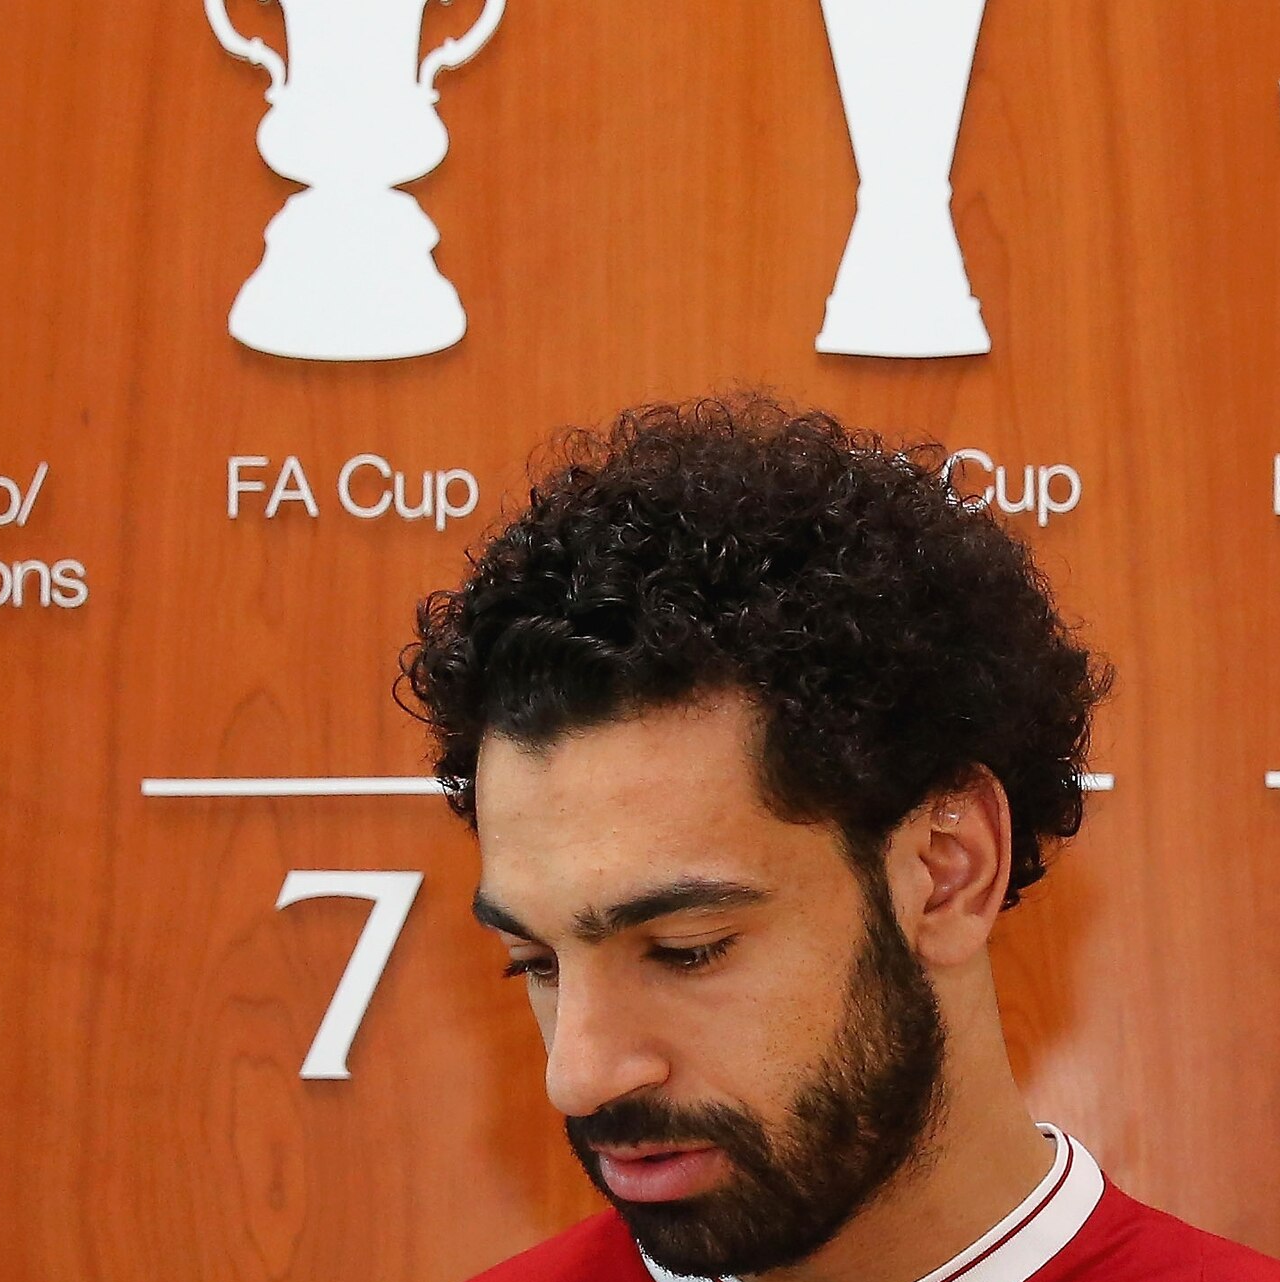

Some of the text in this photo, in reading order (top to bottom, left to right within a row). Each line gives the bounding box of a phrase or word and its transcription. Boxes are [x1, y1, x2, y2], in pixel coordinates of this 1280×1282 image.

[227, 454, 480, 532] FA Cup
[939, 448, 1083, 528] Cup
[274, 870, 425, 1080] 7
